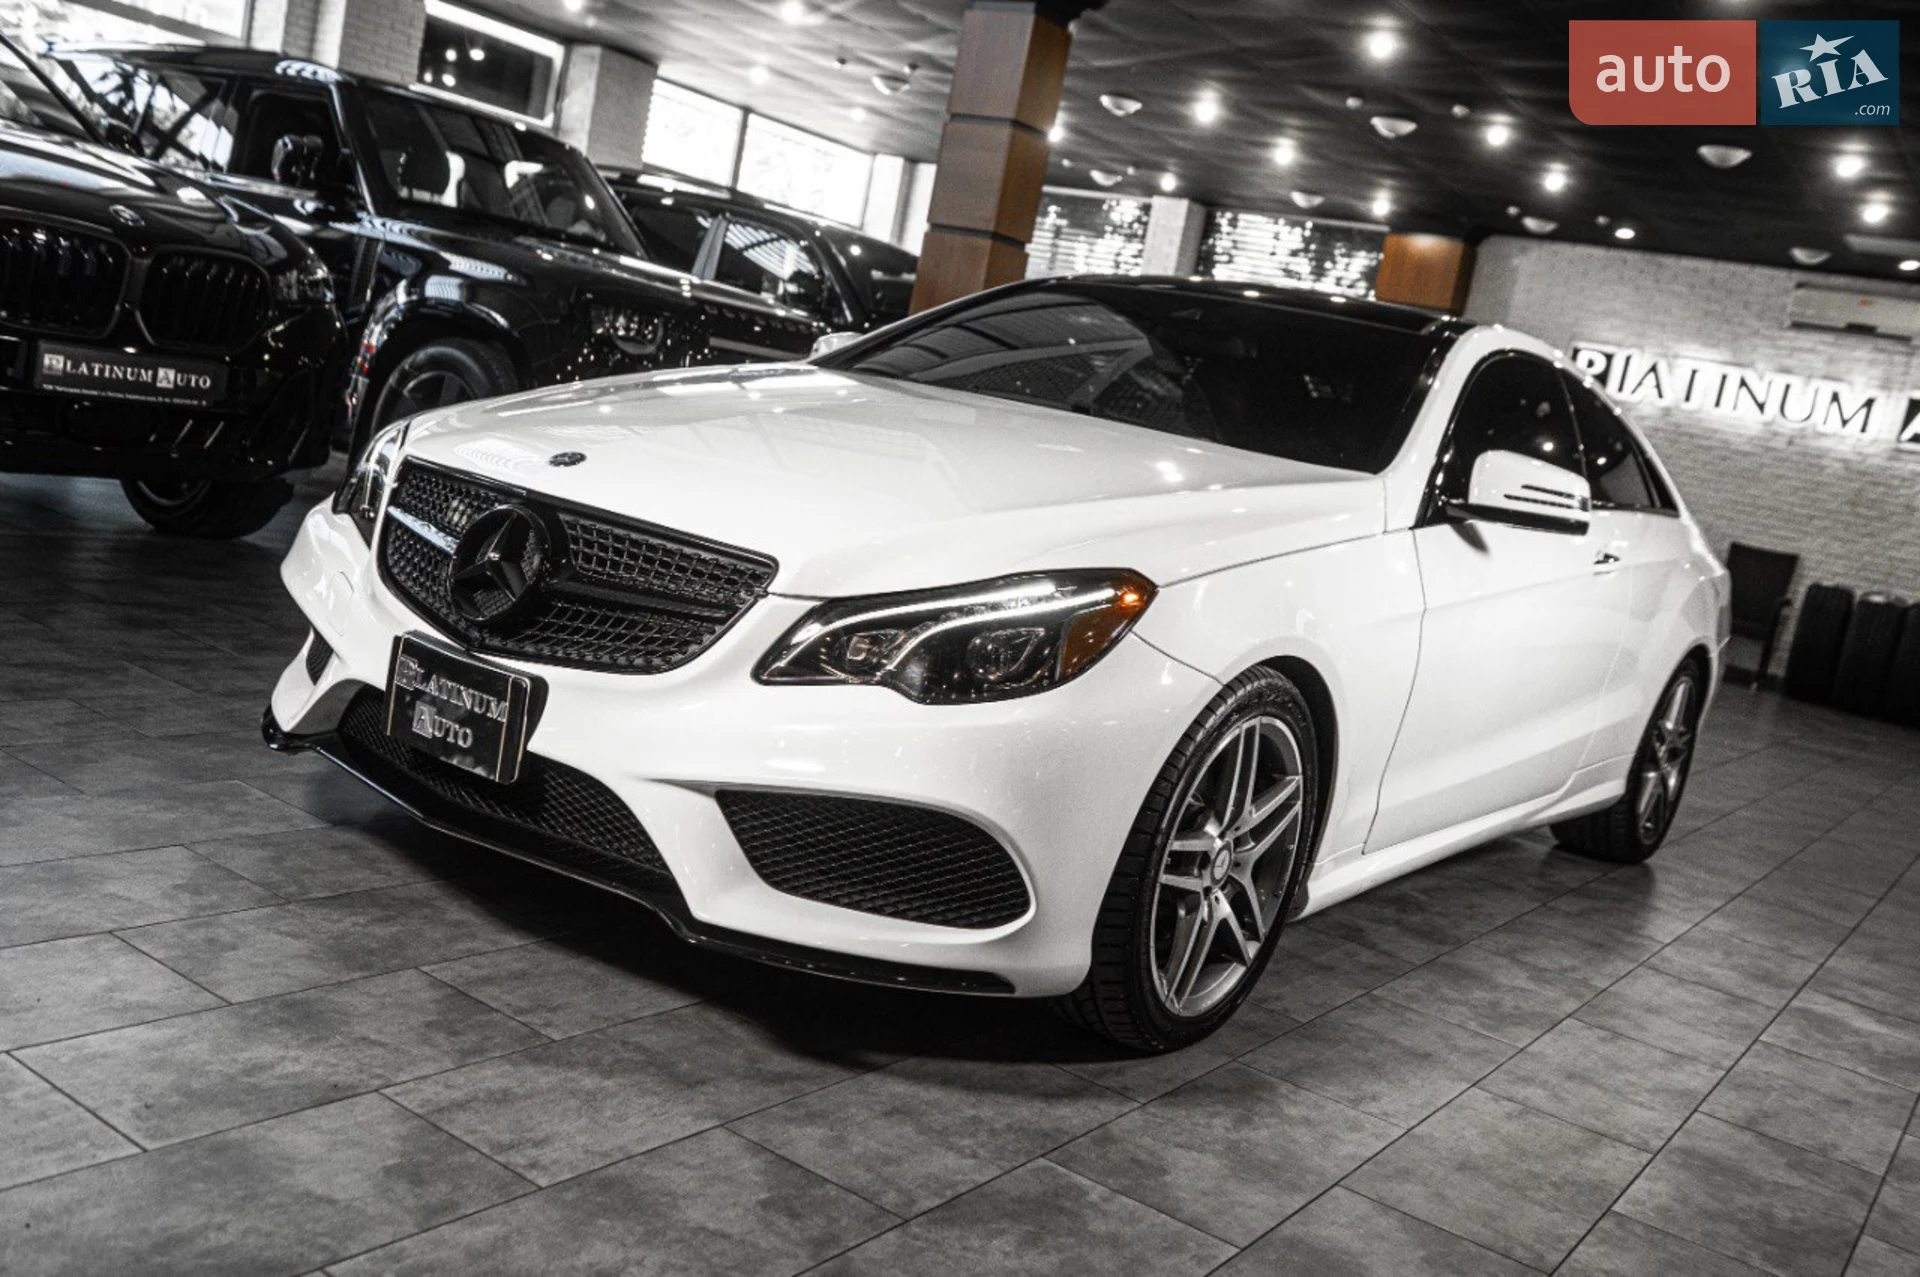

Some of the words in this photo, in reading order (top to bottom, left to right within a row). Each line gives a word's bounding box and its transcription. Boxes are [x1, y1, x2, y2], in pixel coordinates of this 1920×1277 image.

[43, 353, 154, 383] PLATINUM
[156, 367, 211, 389] AUTO
[1571, 346, 1877, 433] PLATINUM
[395, 654, 507, 722] PLATINUM
[412, 700, 473, 748] AUTO
